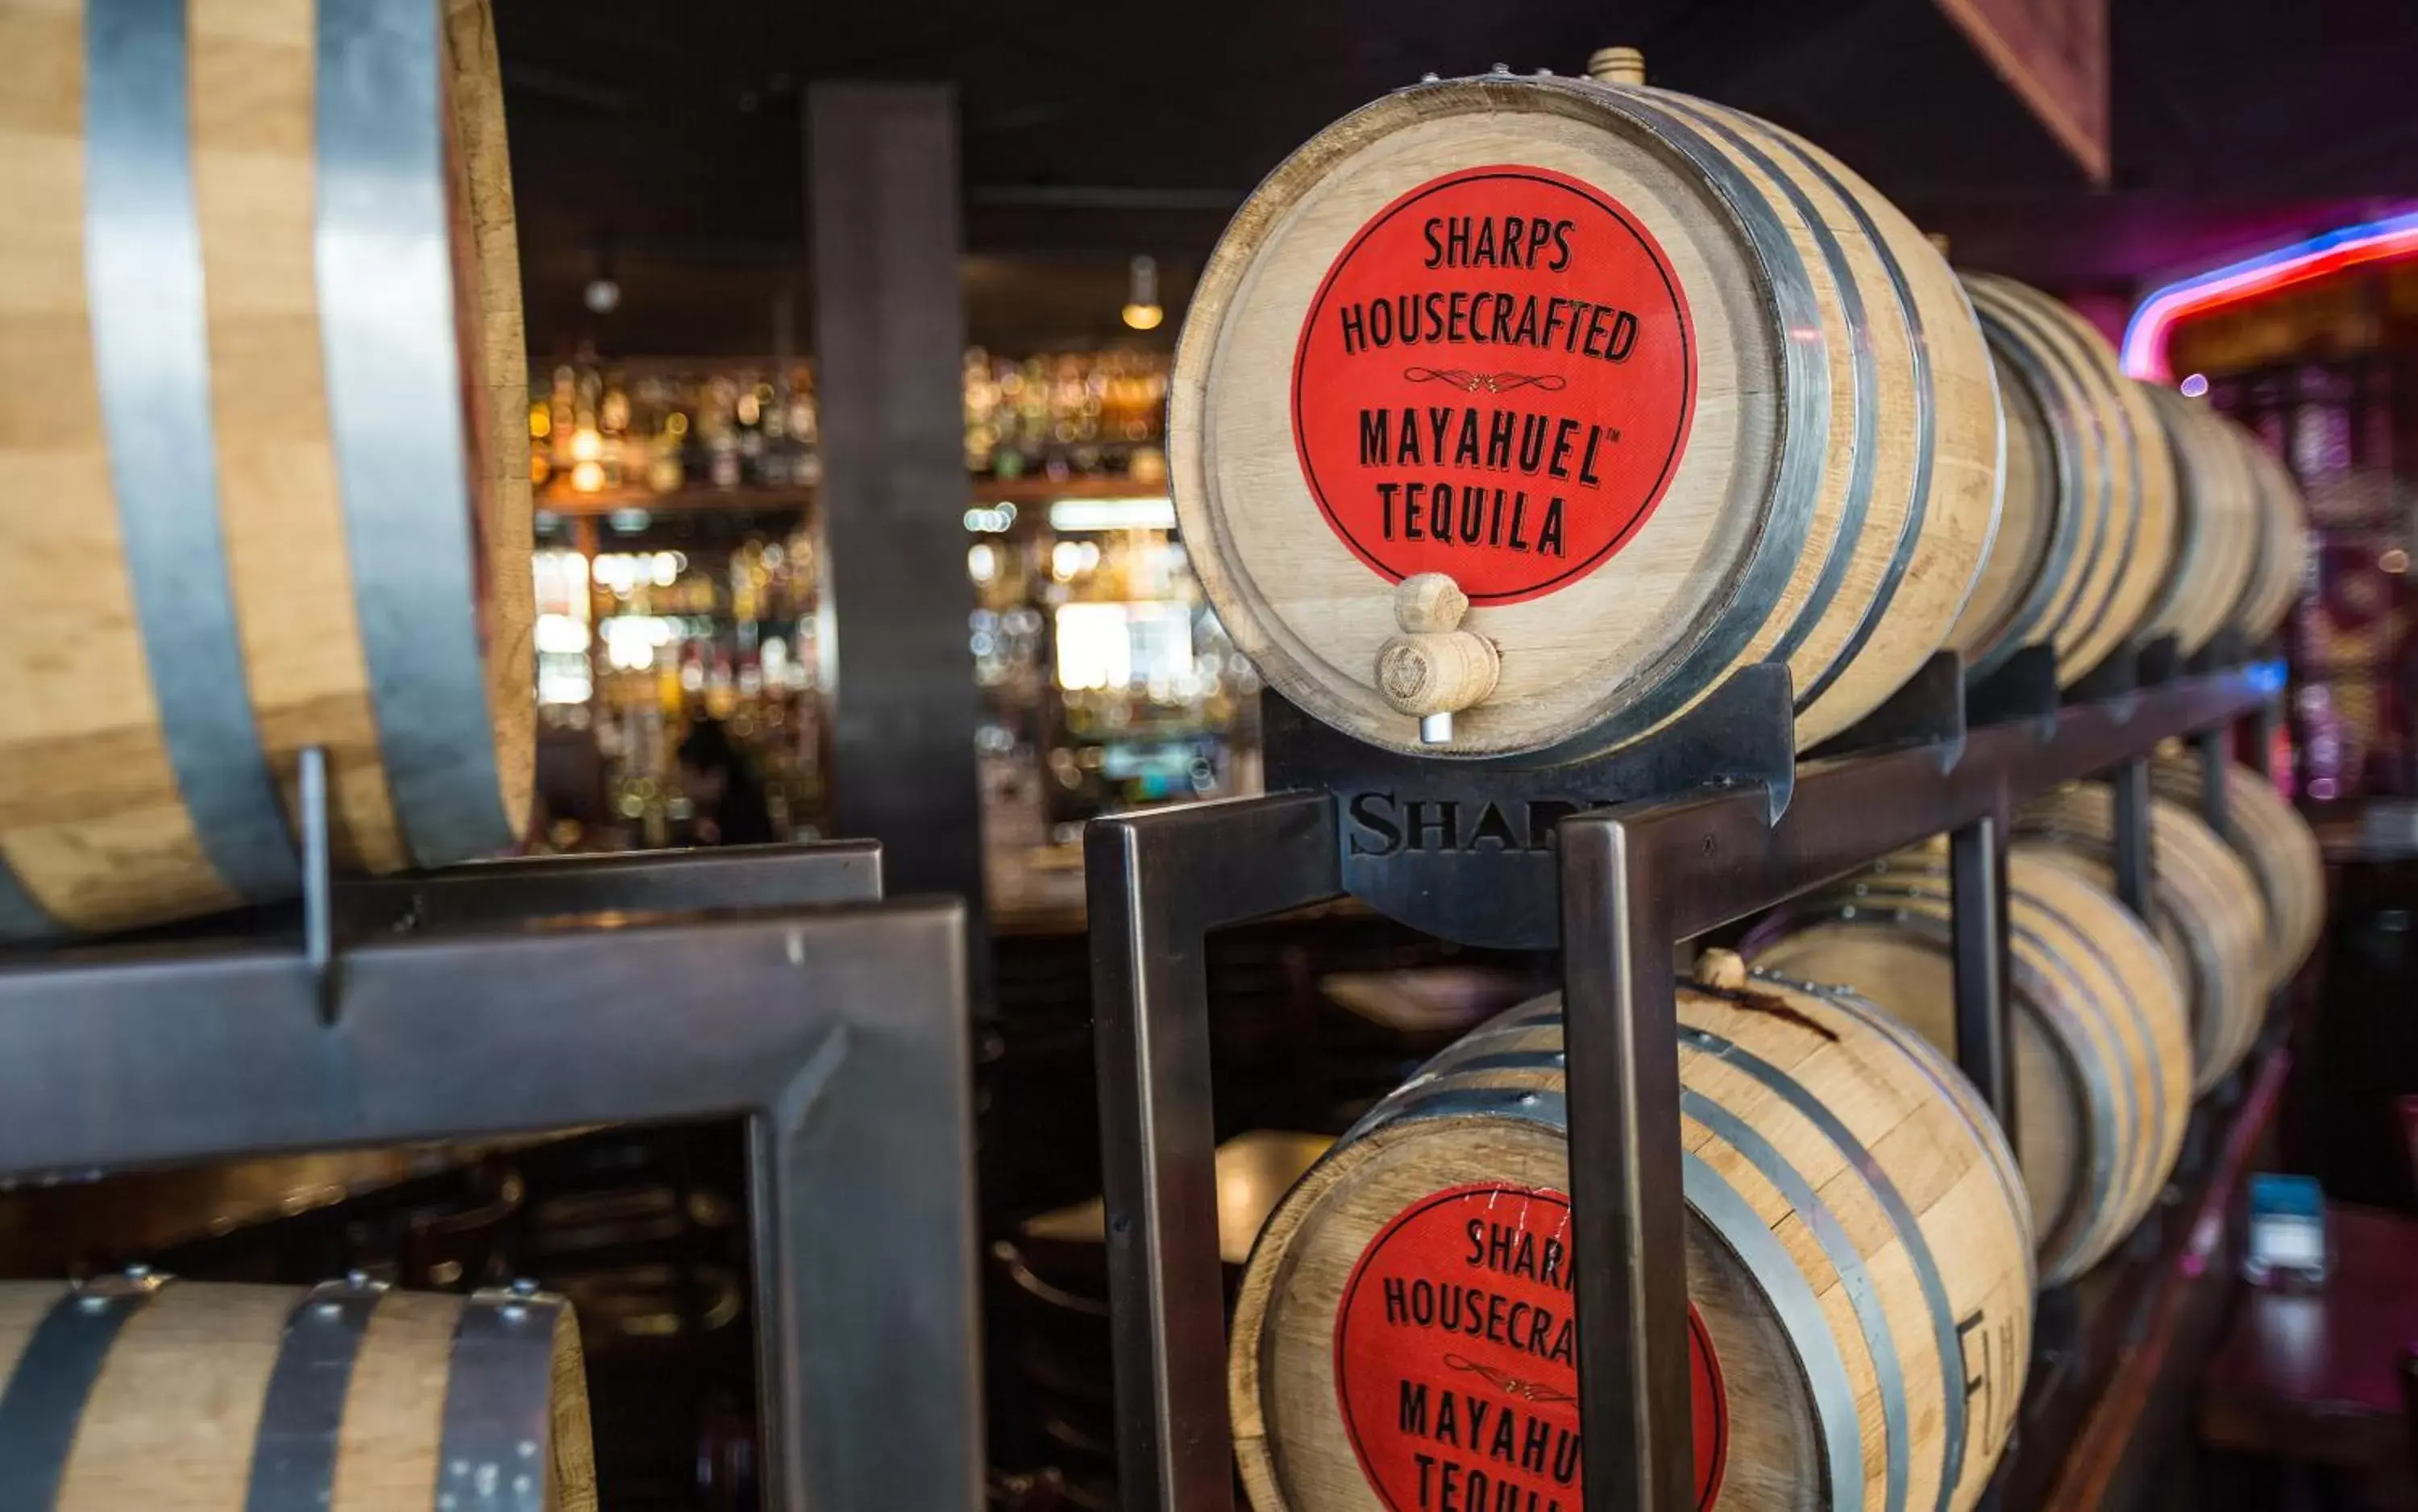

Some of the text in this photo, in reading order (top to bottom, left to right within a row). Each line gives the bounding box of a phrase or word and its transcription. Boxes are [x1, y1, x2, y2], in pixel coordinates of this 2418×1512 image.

[1423, 216, 1575, 272] SHARPS
[1340, 290, 1640, 364] HOUSECRAFTED
[1376, 481, 1568, 560] TEQUILA
[1349, 791, 1624, 857] SHAR
[1465, 1218, 1574, 1292] SHAR
